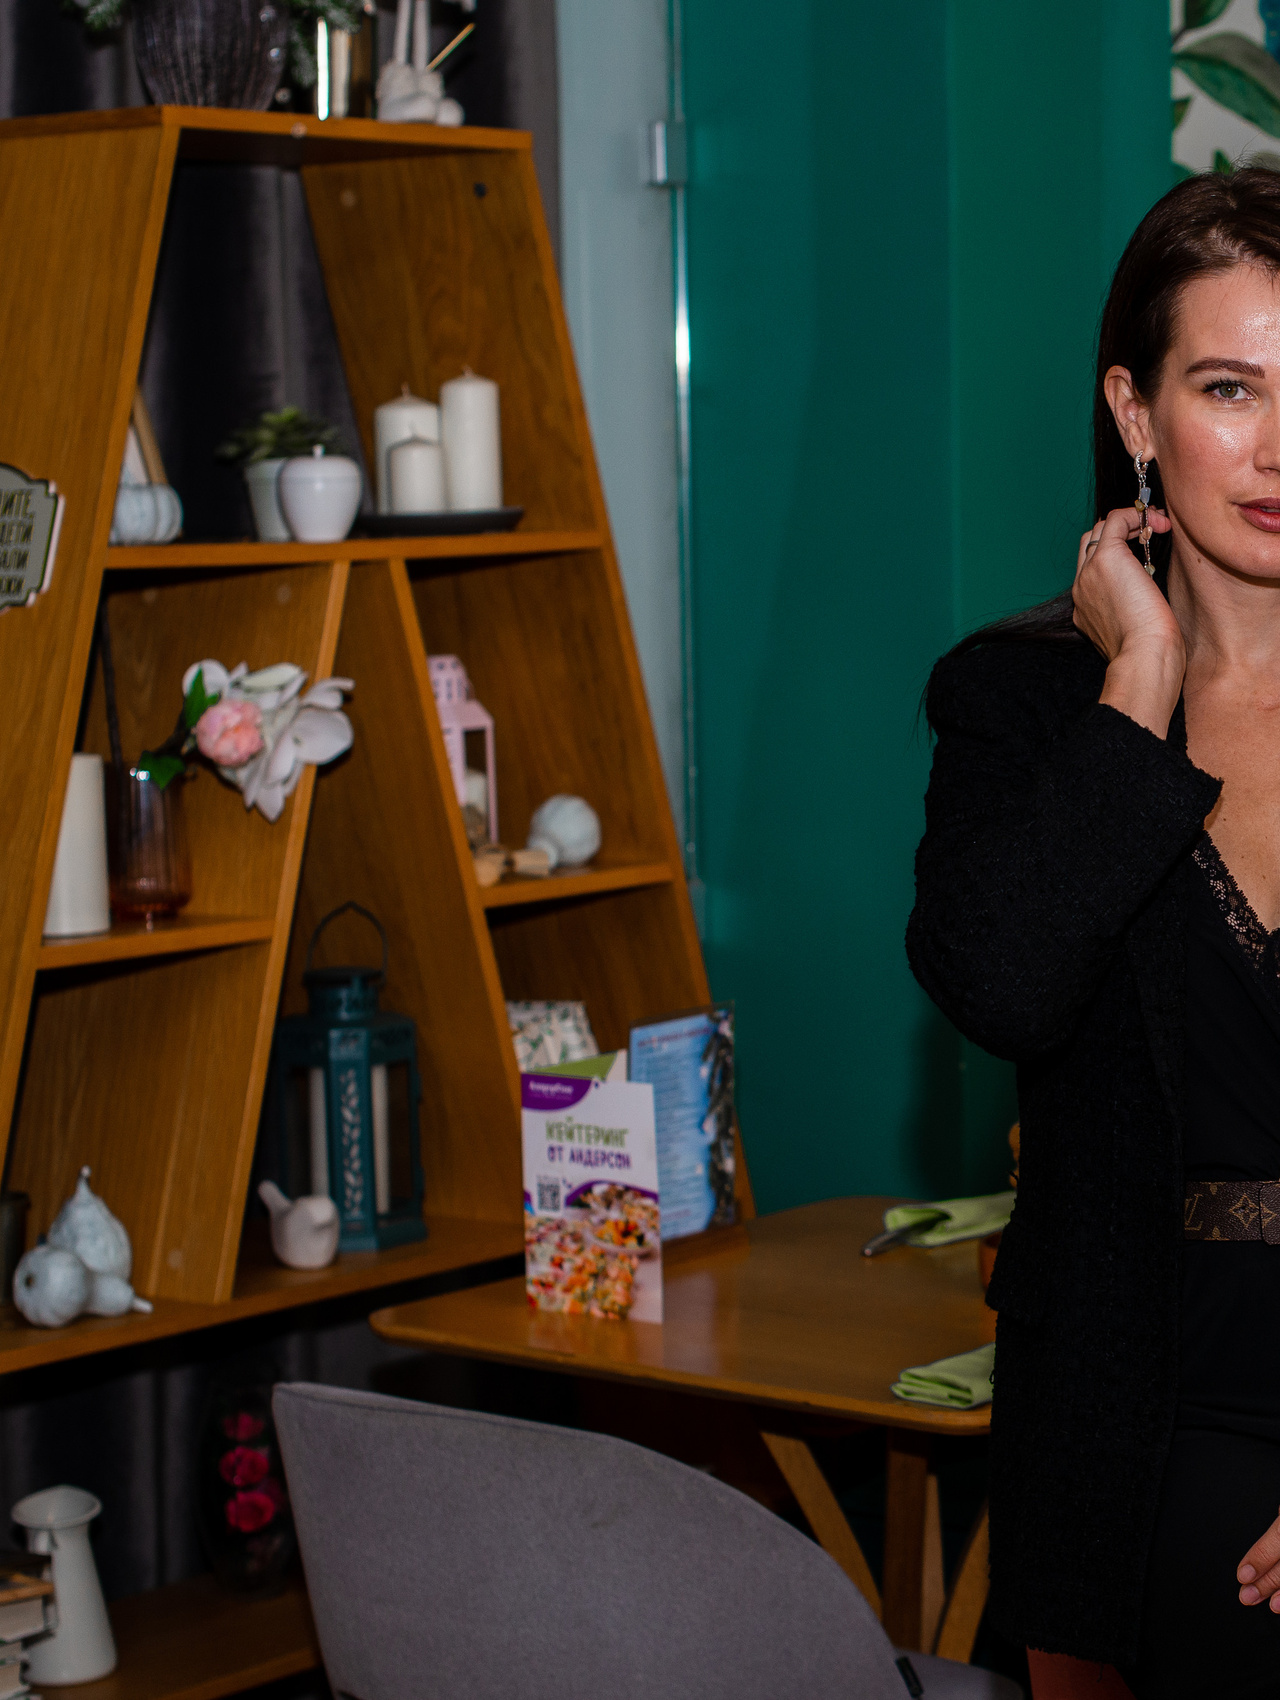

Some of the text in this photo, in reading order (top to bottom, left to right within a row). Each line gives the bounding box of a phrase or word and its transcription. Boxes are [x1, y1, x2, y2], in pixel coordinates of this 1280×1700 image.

[545, 1116, 629, 1147] КЕЙТЕРИНГ
[547, 1145, 631, 1169] ОТ АНДЕРСОН
